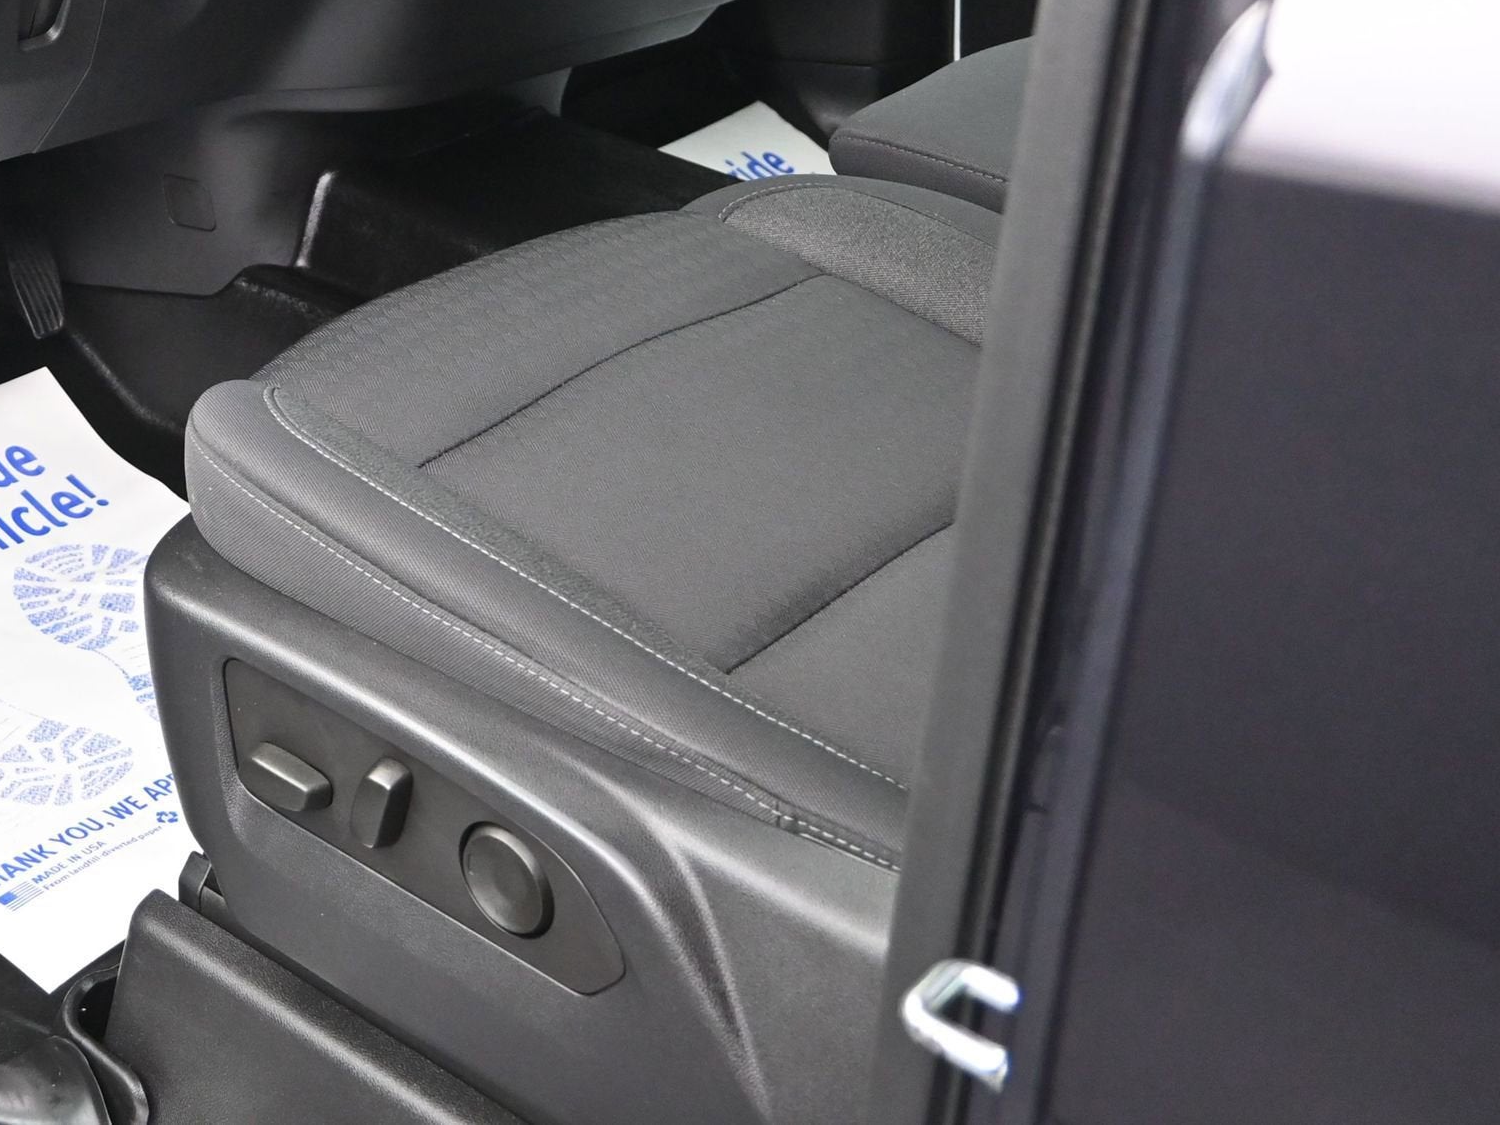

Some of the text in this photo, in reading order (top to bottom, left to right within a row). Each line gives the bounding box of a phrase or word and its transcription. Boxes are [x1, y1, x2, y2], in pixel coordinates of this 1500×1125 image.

[725, 151, 794, 179] ide
[48, 816, 116, 847] YOU,
[102, 795, 148, 820] WE
[31, 840, 107, 885] MADE IN USA
[43, 874, 71, 891] From
[138, 825, 163, 840] paper
